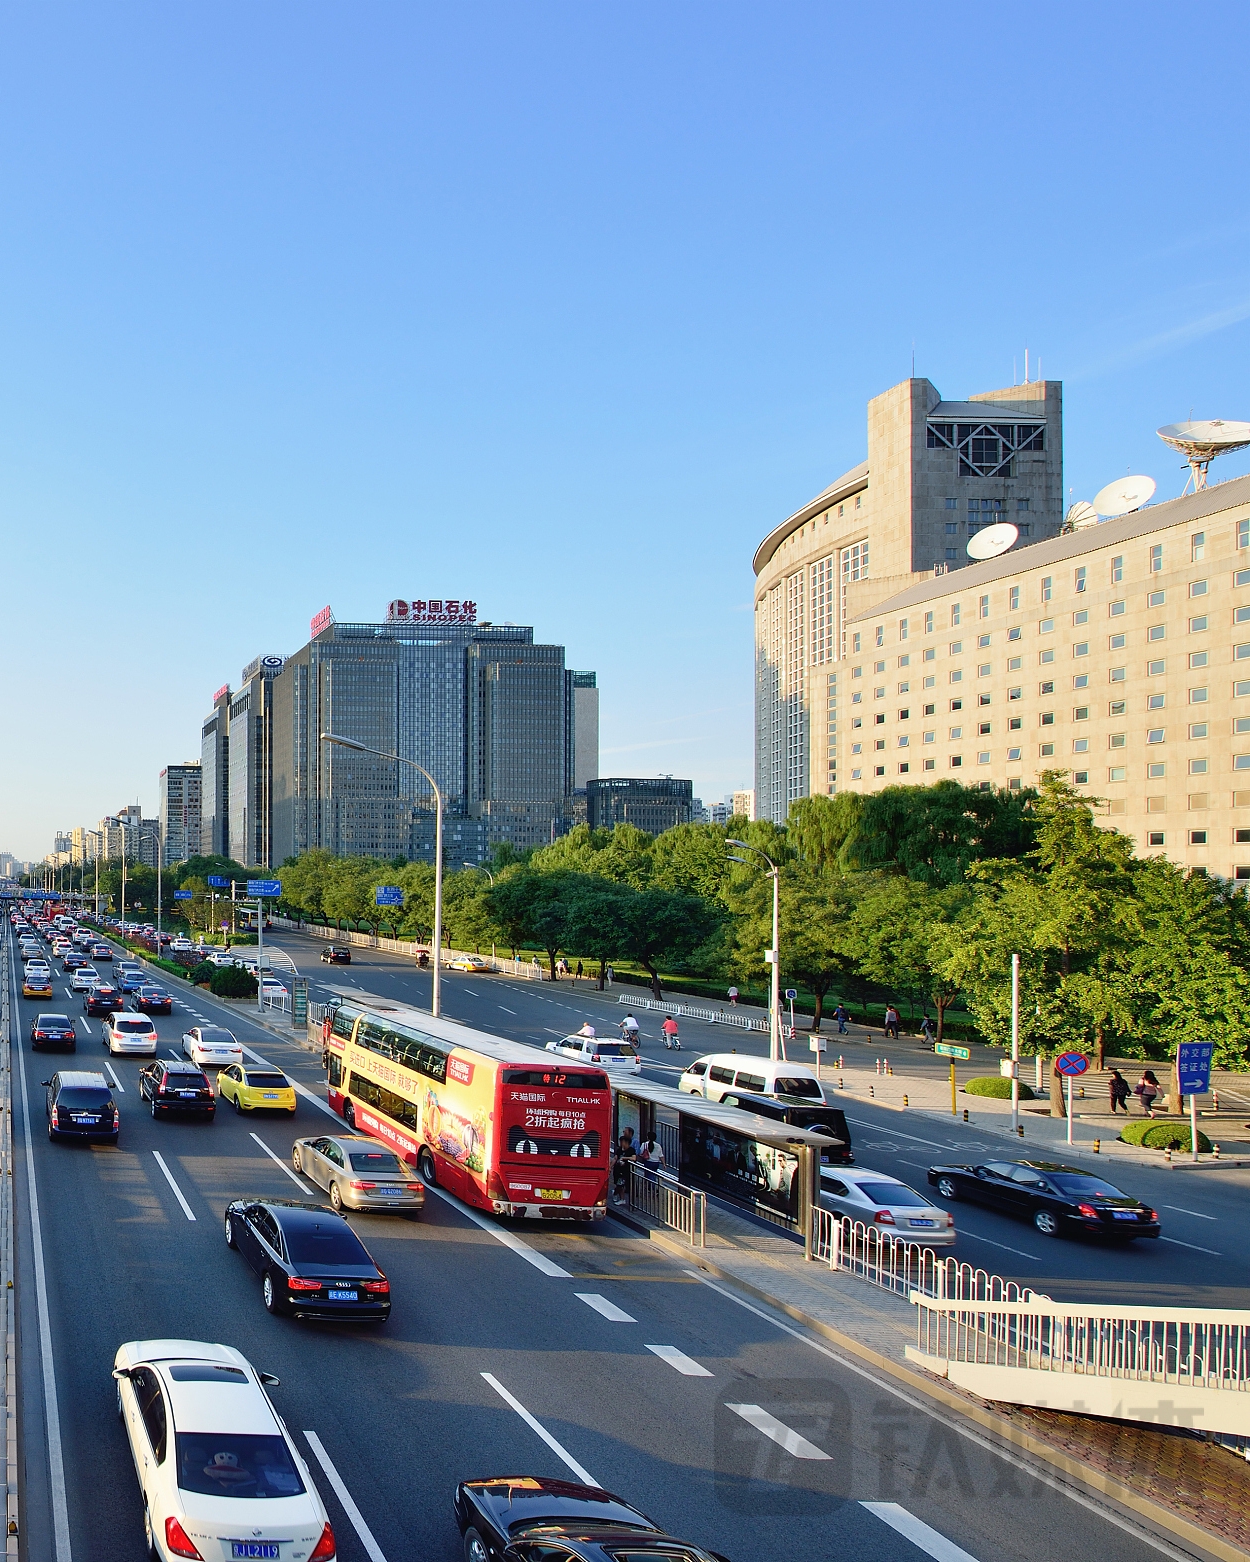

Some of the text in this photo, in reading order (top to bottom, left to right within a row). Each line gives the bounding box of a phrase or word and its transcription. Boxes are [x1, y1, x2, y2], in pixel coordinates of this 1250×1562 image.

[412, 600, 477, 614] 中国石化
[413, 614, 477, 622] SINOPEC
[1181, 1048, 1210, 1058] 外交部
[450, 1058, 470, 1074] 天猫国际
[1180, 1062, 1208, 1073] 签证处
[554, 1074, 567, 1085] 12
[510, 1091, 546, 1102] 天猫国际
[566, 1096, 601, 1105] TMALL.HK
[525, 1115, 586, 1130] 2折起疯抢
